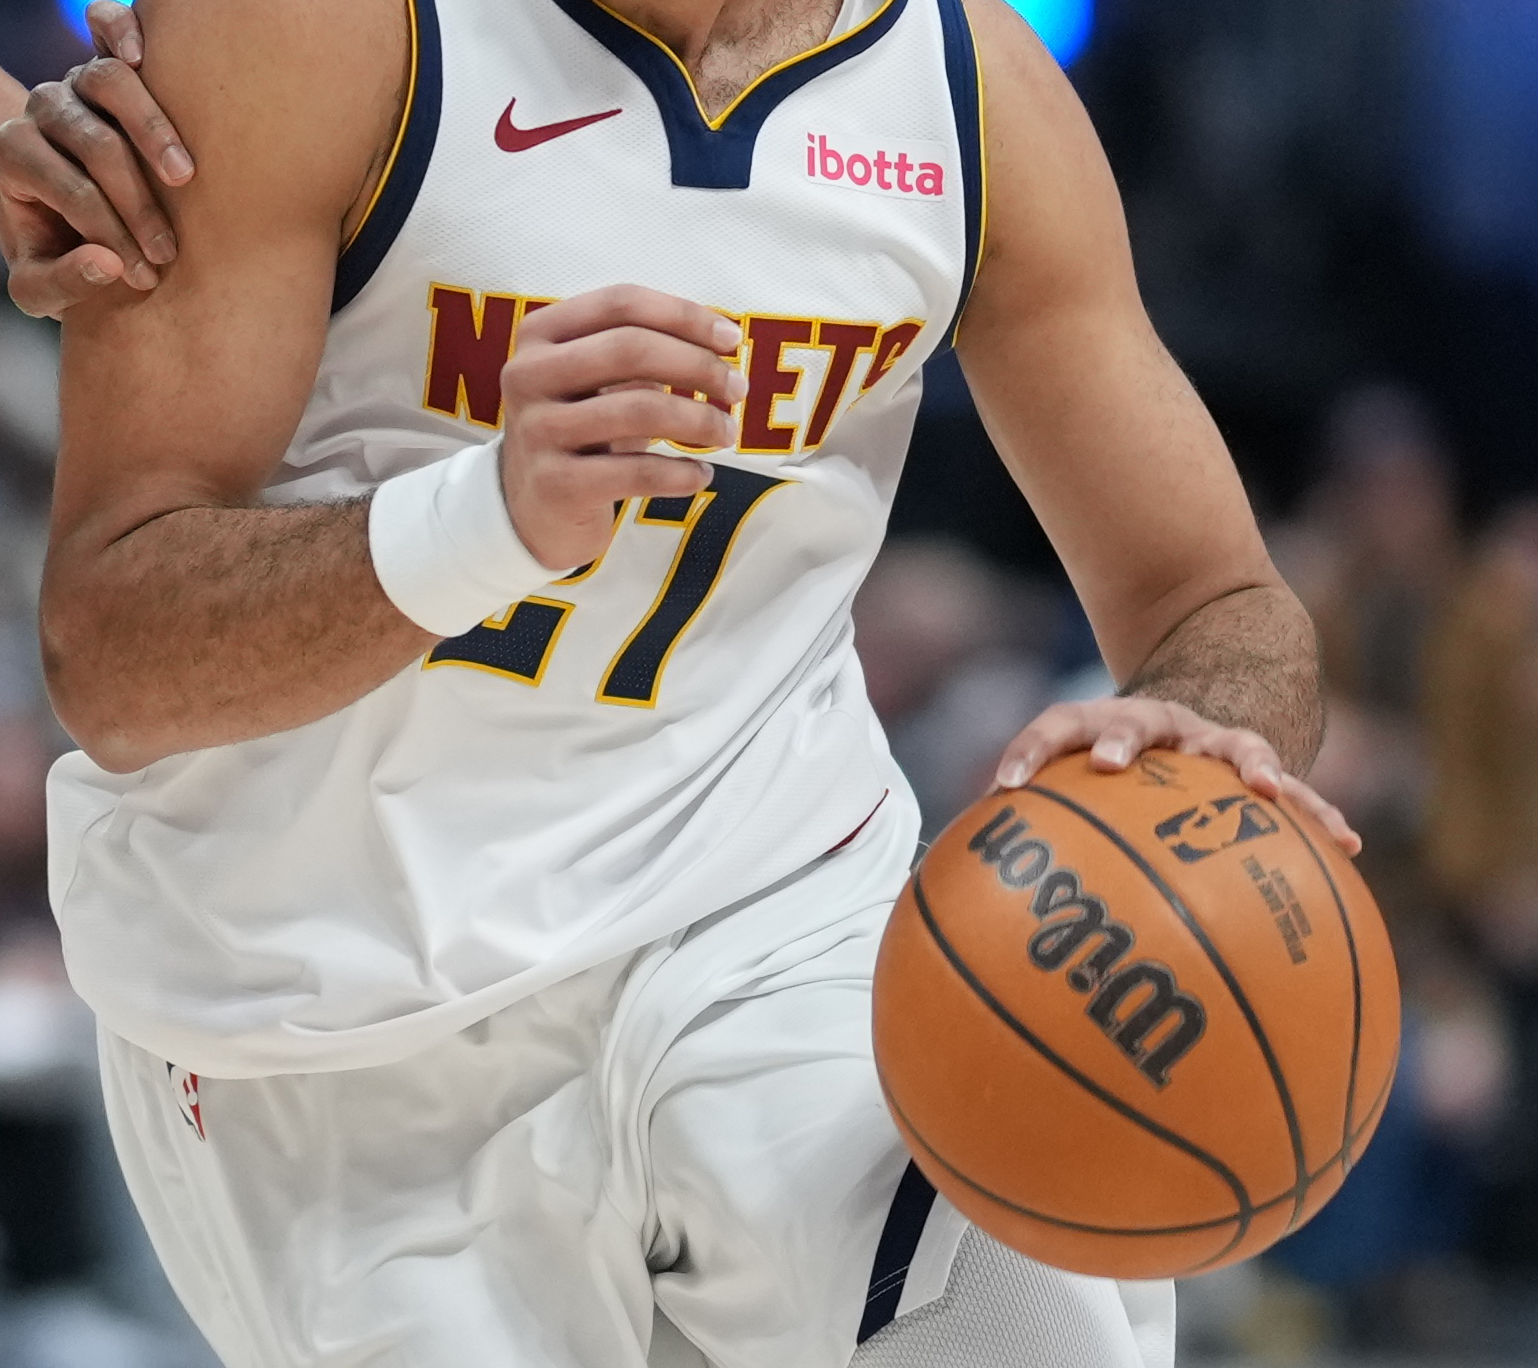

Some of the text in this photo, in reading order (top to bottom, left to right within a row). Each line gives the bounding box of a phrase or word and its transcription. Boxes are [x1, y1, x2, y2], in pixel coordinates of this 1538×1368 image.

[807, 132, 944, 196] ibotta
[423, 281, 927, 455] NETS
[967, 804, 1207, 1090] Wilson
